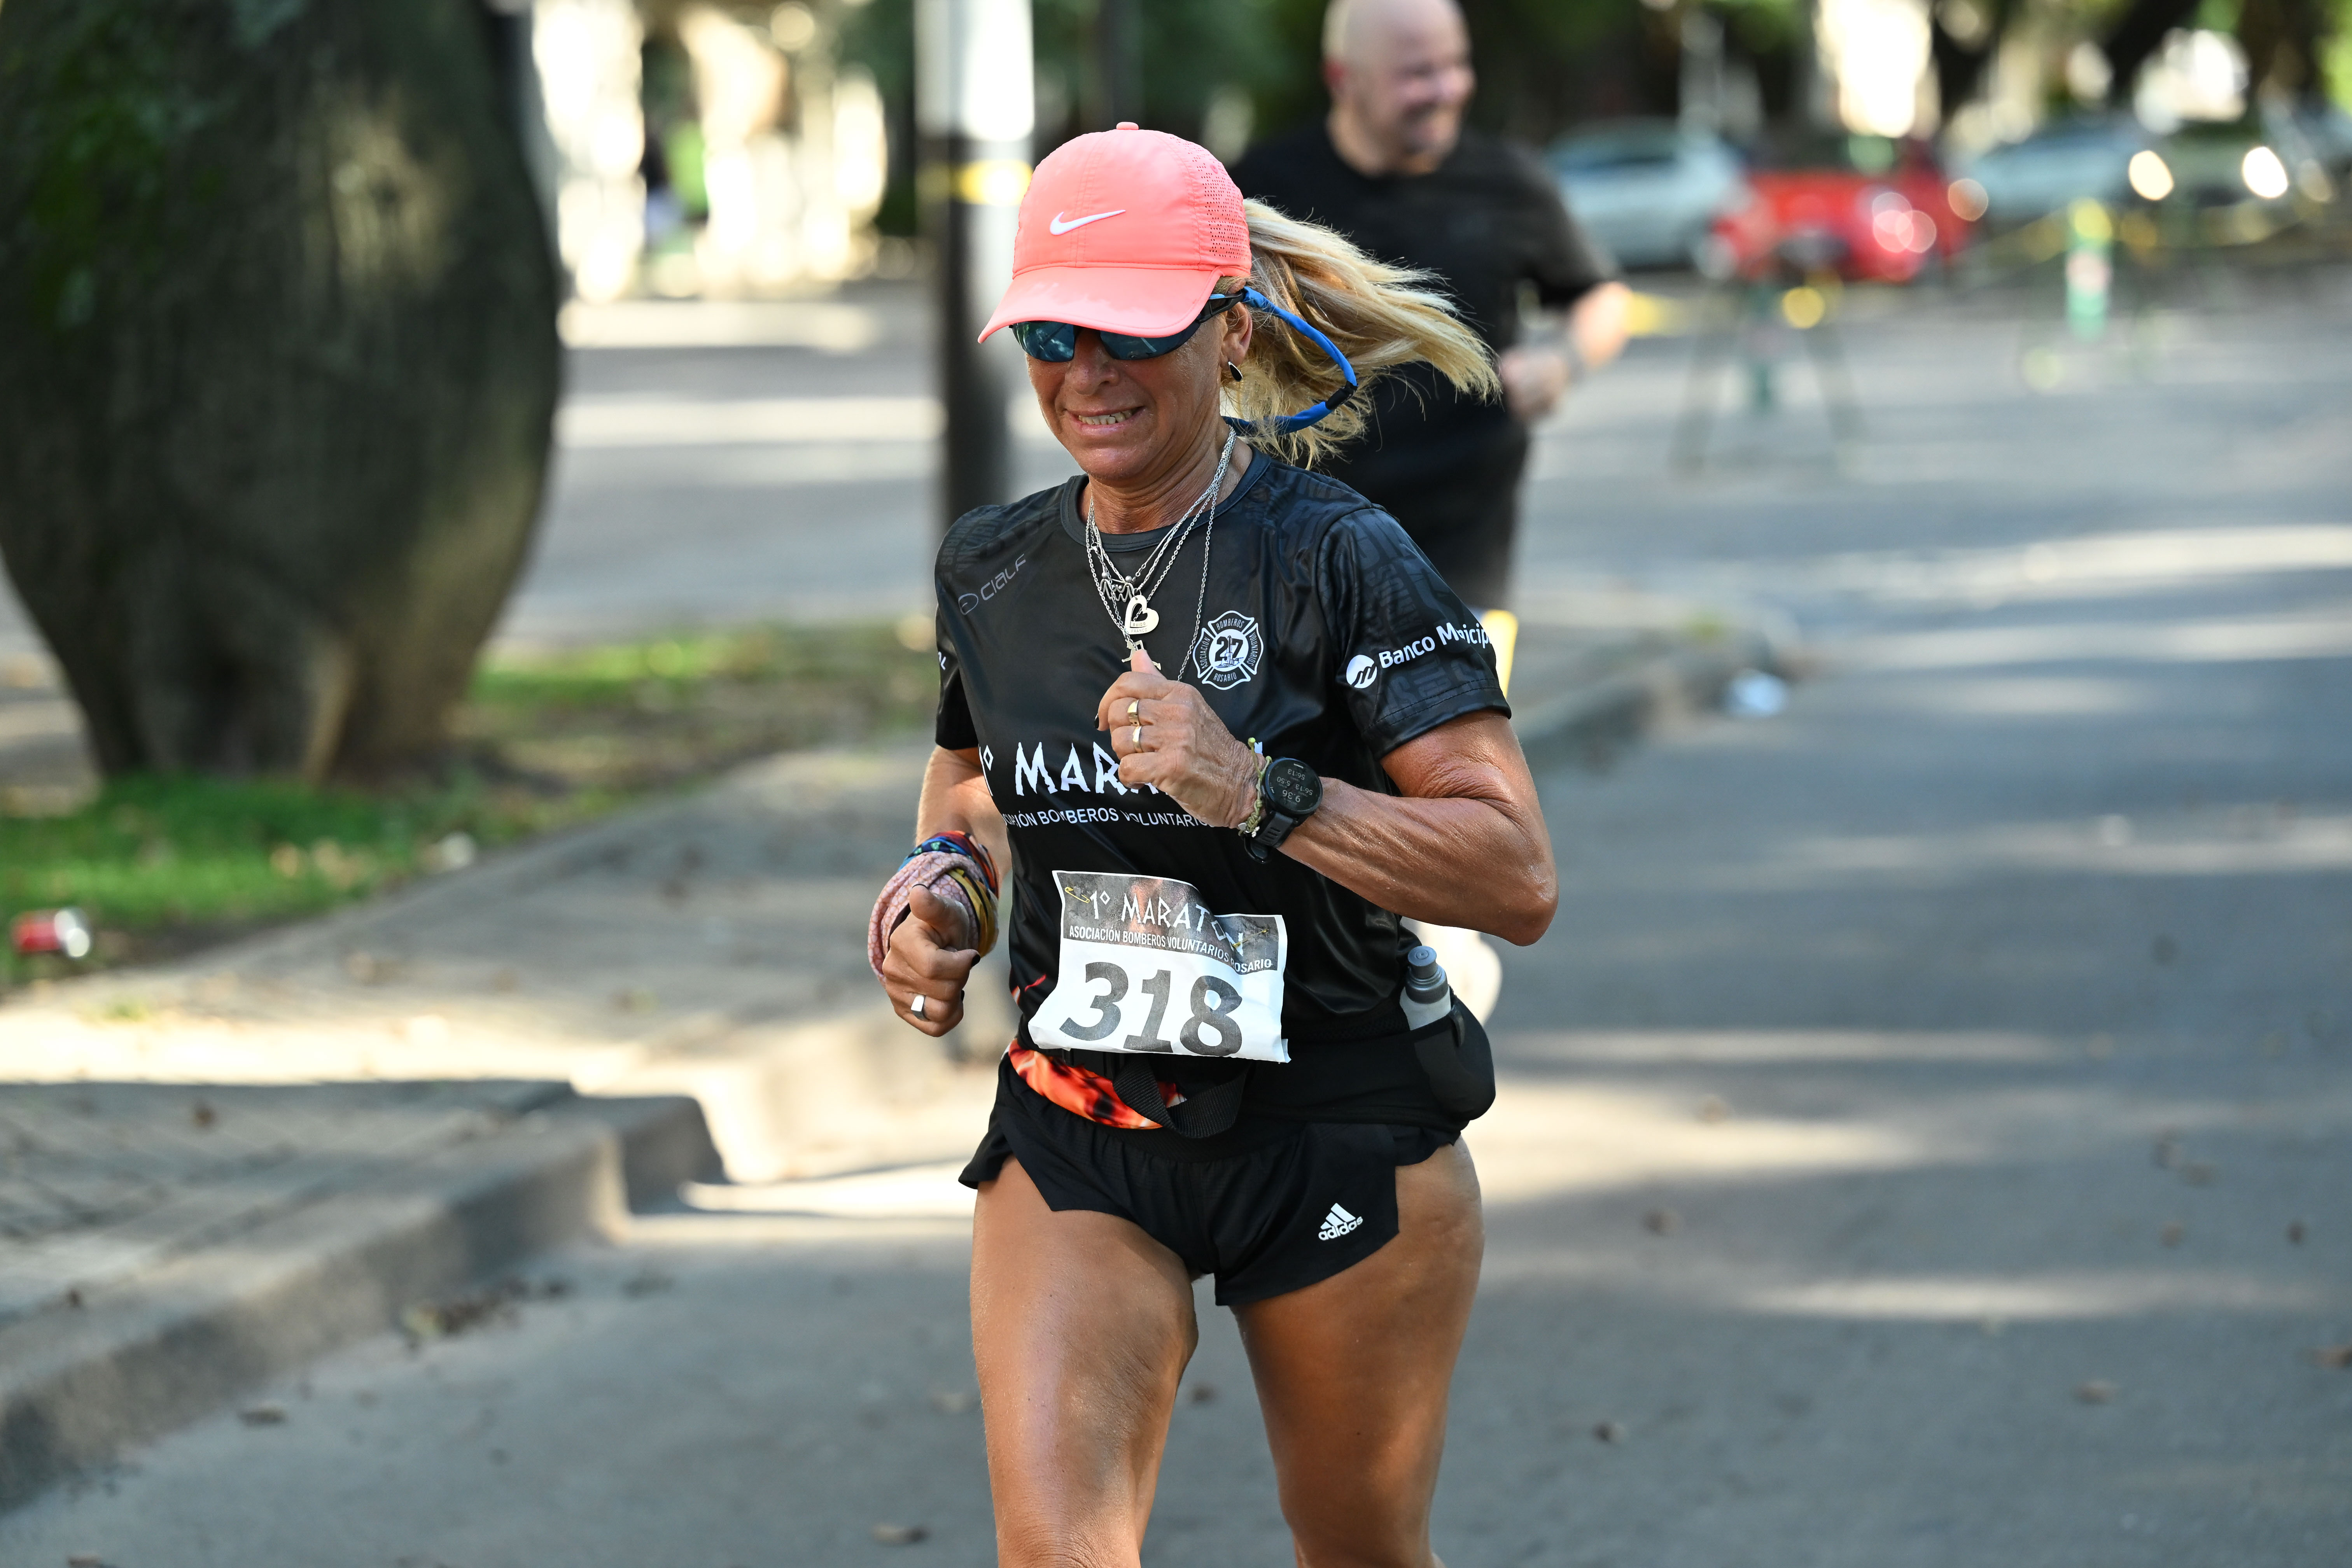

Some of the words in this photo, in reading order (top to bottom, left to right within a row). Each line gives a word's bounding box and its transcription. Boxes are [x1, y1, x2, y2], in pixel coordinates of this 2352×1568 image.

[1216, 618, 1244, 630] BOMBEROS
[1199, 637, 1211, 669] ASOCIACIÓN
[1214, 636, 1243, 662] 27
[1246, 632, 1258, 666] VOLUNTARIOS
[1379, 636, 1435, 668] Banco
[1213, 672, 1237, 682] ROSARIO
[1277, 777, 1291, 786] 5:50
[1288, 768, 1306, 780] 56:13
[1282, 789, 1300, 803] 9.36
[1295, 784, 1313, 795] 56:13
[1120, 810, 1215, 828] VOLUNTARI
[1121, 892, 1244, 957] MARATON
[1069, 925, 1120, 942] ASOCIACIÓN
[1122, 931, 1166, 947] BOMBEROS
[1167, 935, 1229, 962] VOLUNTARIOS
[1230, 959, 1272, 973] ROSARIO
[1059, 961, 1242, 1057] 318
[1318, 1216, 1363, 1241] adidas
